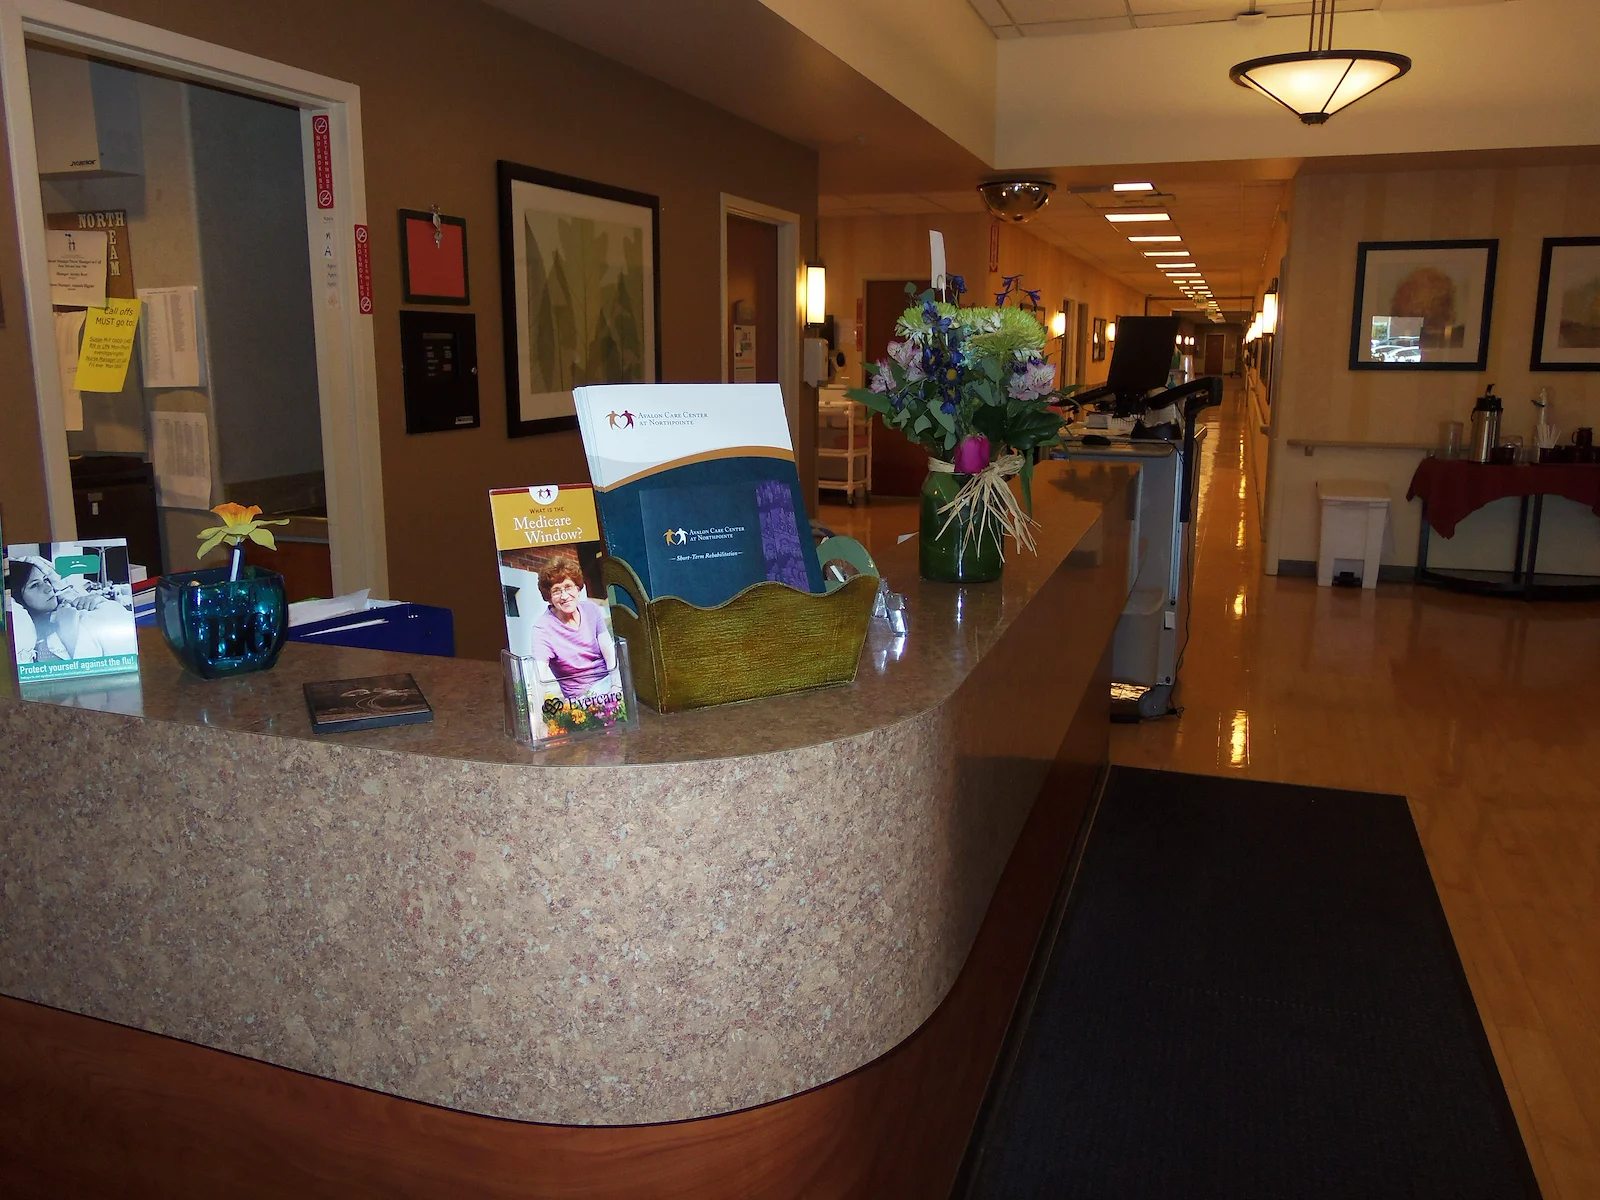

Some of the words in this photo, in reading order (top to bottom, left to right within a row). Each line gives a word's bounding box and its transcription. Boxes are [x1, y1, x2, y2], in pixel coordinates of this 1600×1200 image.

[78, 212, 125, 229] NORTH
[104, 307, 118, 315] Call
[119, 307, 133, 316] offs
[95, 317, 115, 325] MUST
[664, 411, 681, 419] CARE
[682, 411, 709, 419] CENTER
[512, 514, 572, 531] Medicare
[524, 526, 583, 545] Window?
[20, 665, 47, 675] Protect
[48, 661, 79, 673] yourself
[80, 659, 107, 671] against
[108, 657, 121, 667] the
[122, 656, 134, 665] flu!
[568, 691, 622, 710] Evercare
